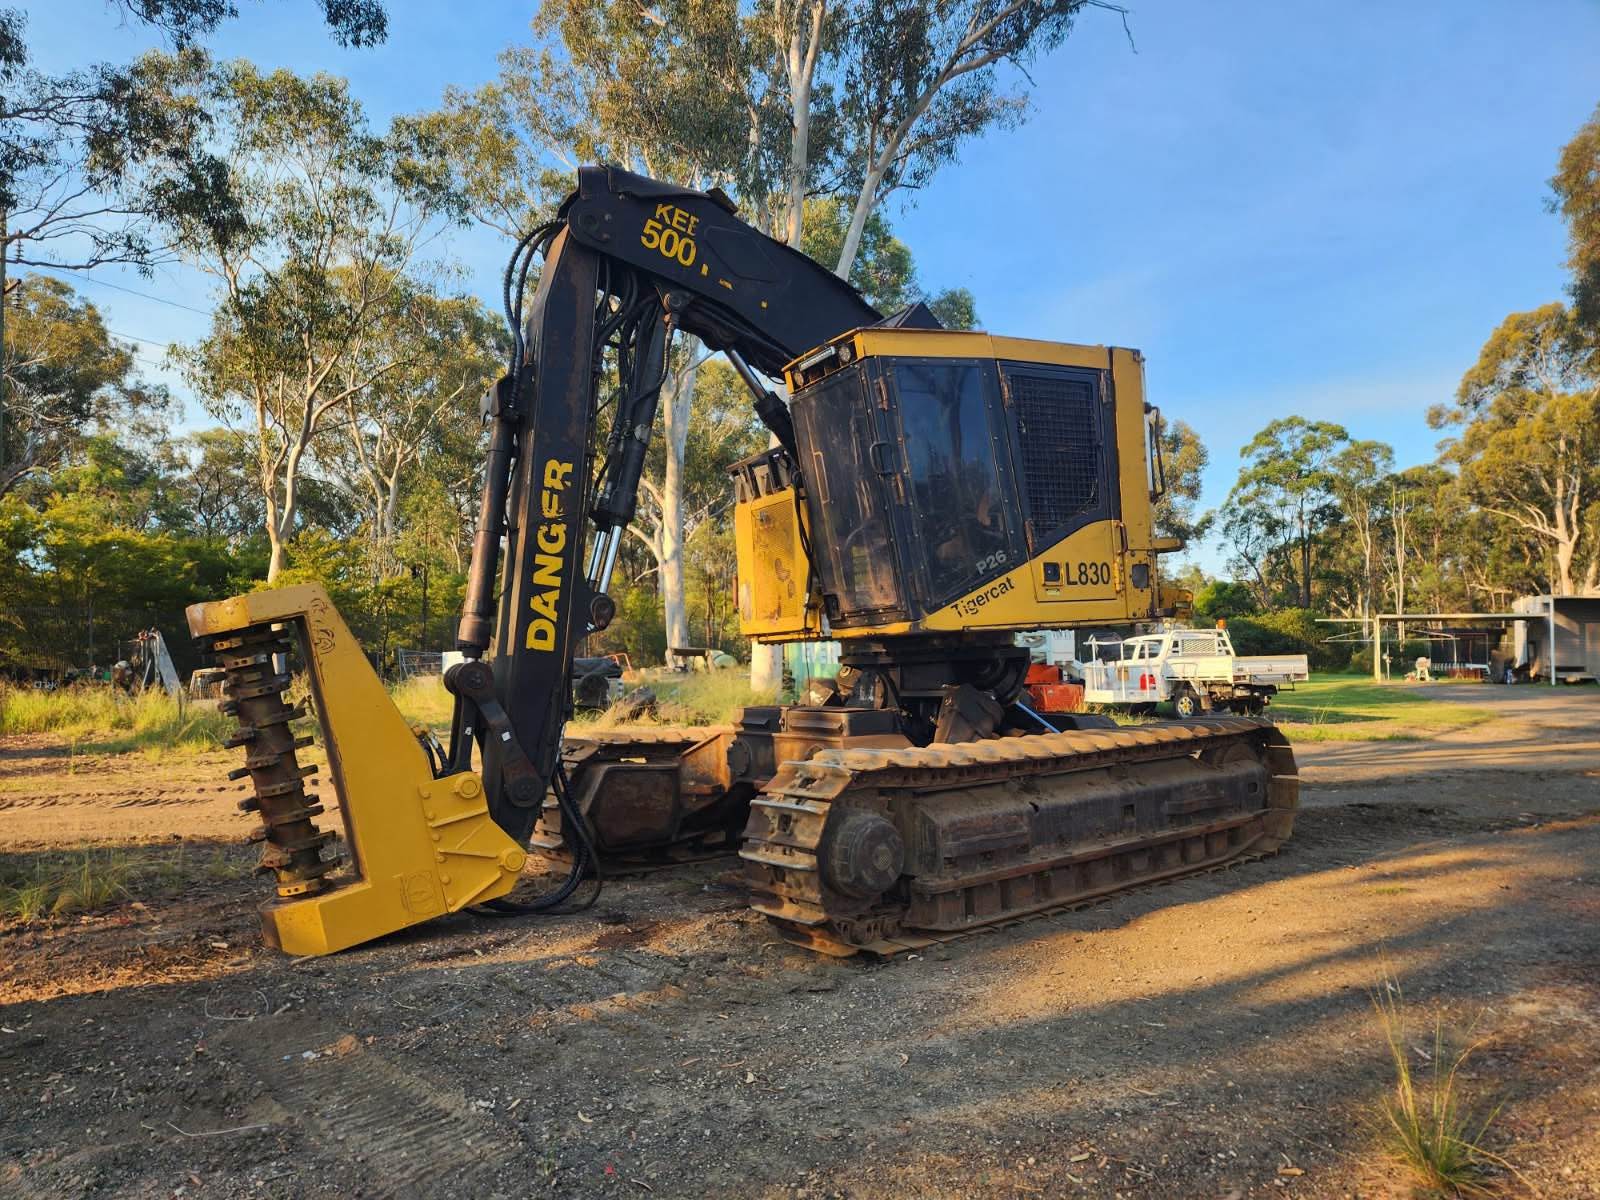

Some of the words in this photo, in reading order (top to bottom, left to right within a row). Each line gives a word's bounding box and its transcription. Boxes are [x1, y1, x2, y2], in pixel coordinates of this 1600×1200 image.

[641, 218, 697, 267] 500
[975, 549, 1008, 576] P26
[1065, 562, 1111, 586] L830
[950, 575, 1015, 618] Tigercat
